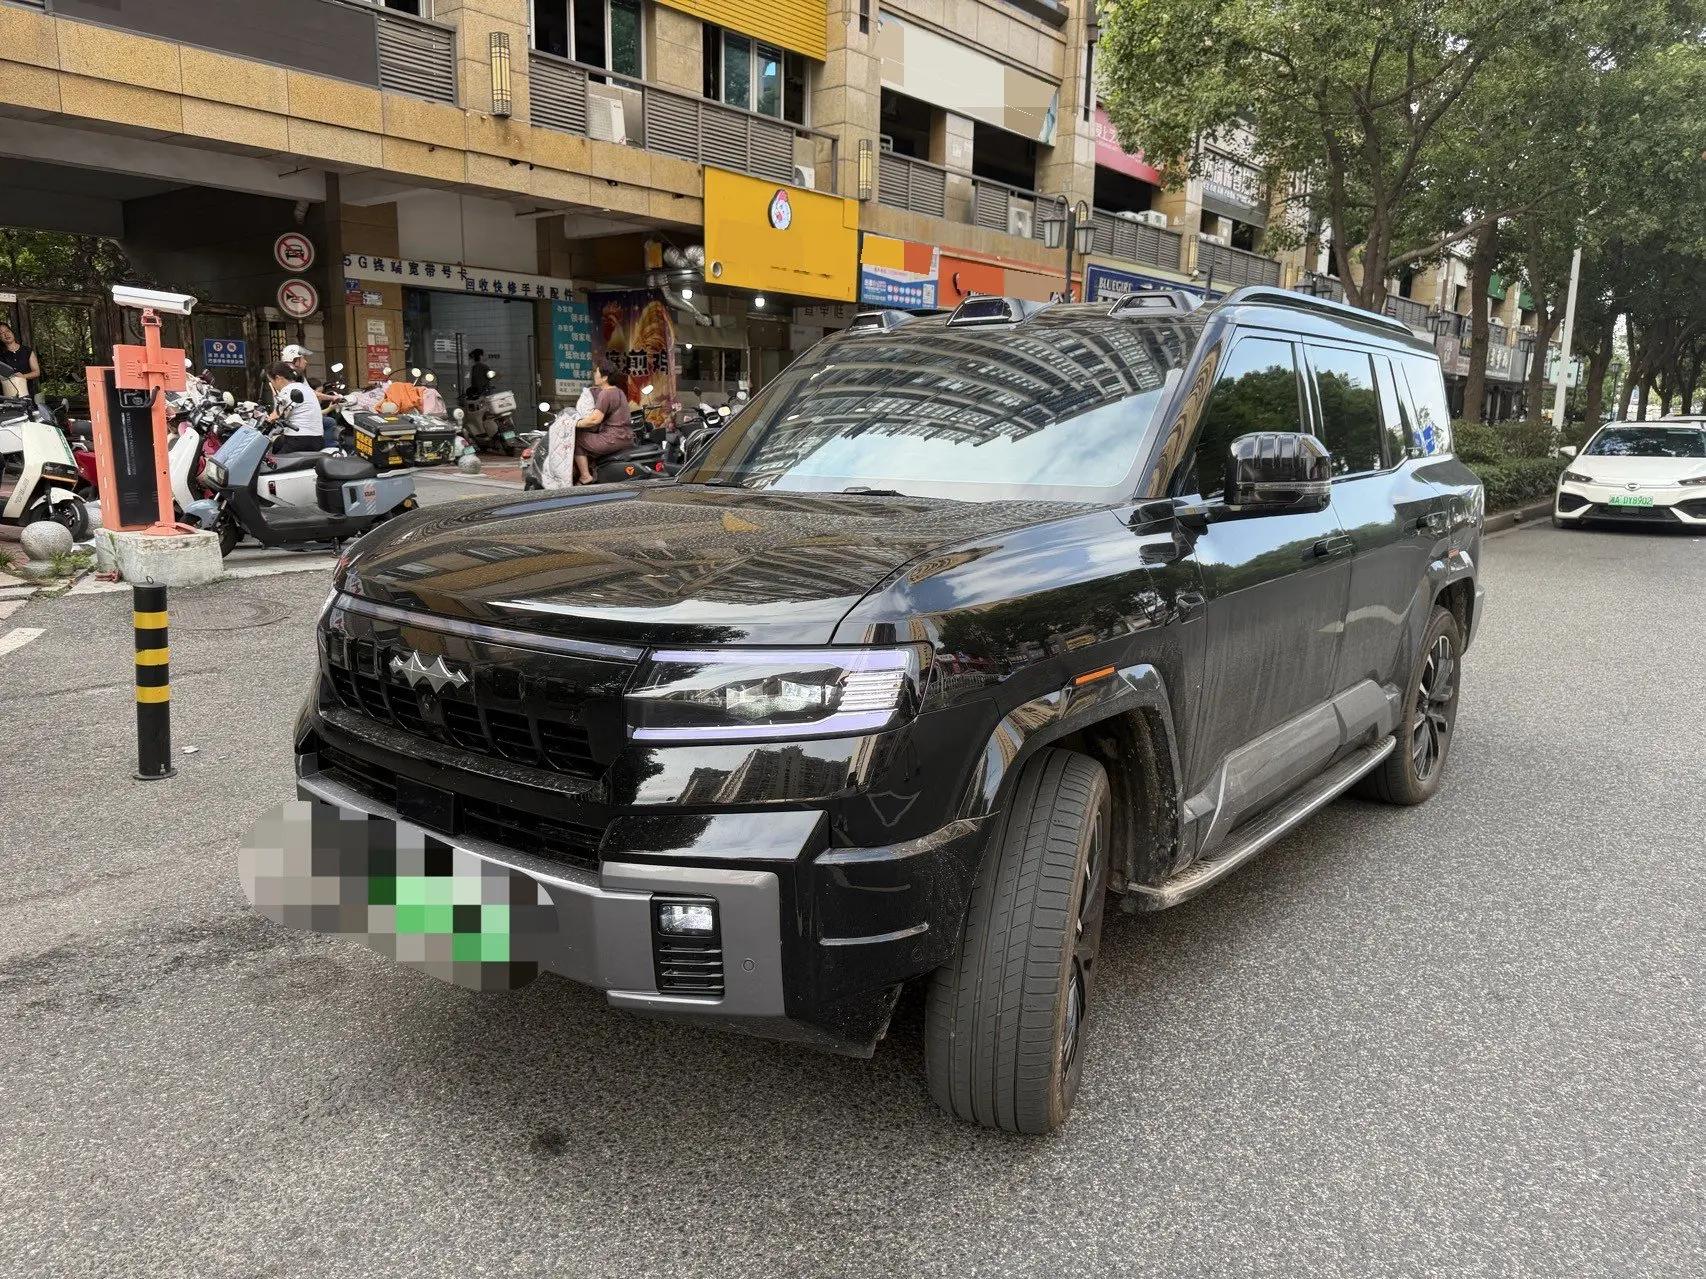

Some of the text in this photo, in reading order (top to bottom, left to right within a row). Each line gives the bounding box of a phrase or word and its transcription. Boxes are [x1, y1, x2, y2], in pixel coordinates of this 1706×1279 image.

[343, 253, 467, 281] 5G终端宽带号卡
[465, 278, 574, 301] 回收快修手机配件
